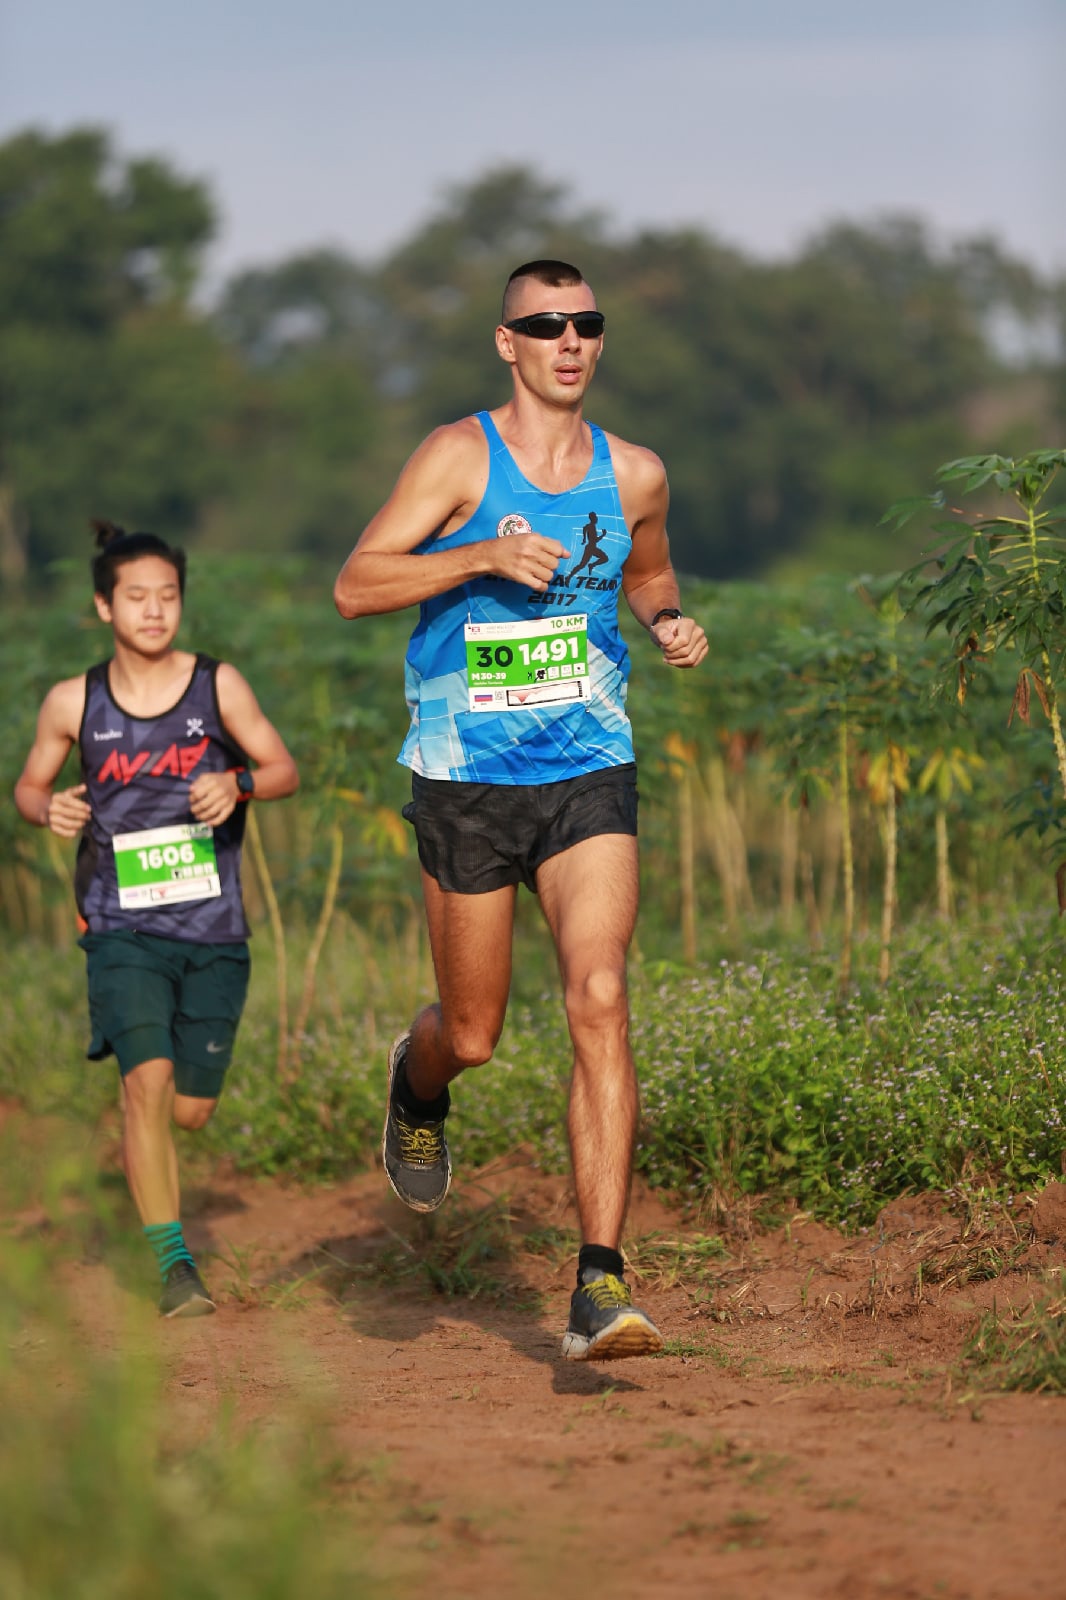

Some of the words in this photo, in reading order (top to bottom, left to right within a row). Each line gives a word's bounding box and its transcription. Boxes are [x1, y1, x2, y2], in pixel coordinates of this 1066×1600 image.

[576, 576, 617, 591] TEAM
[528, 592, 577, 606] 2017
[551, 619, 563, 629] 10
[566, 617, 584, 626] KM
[476, 646, 513, 668] 30
[518, 636, 578, 666] 1491
[138, 843, 195, 872] 1606
